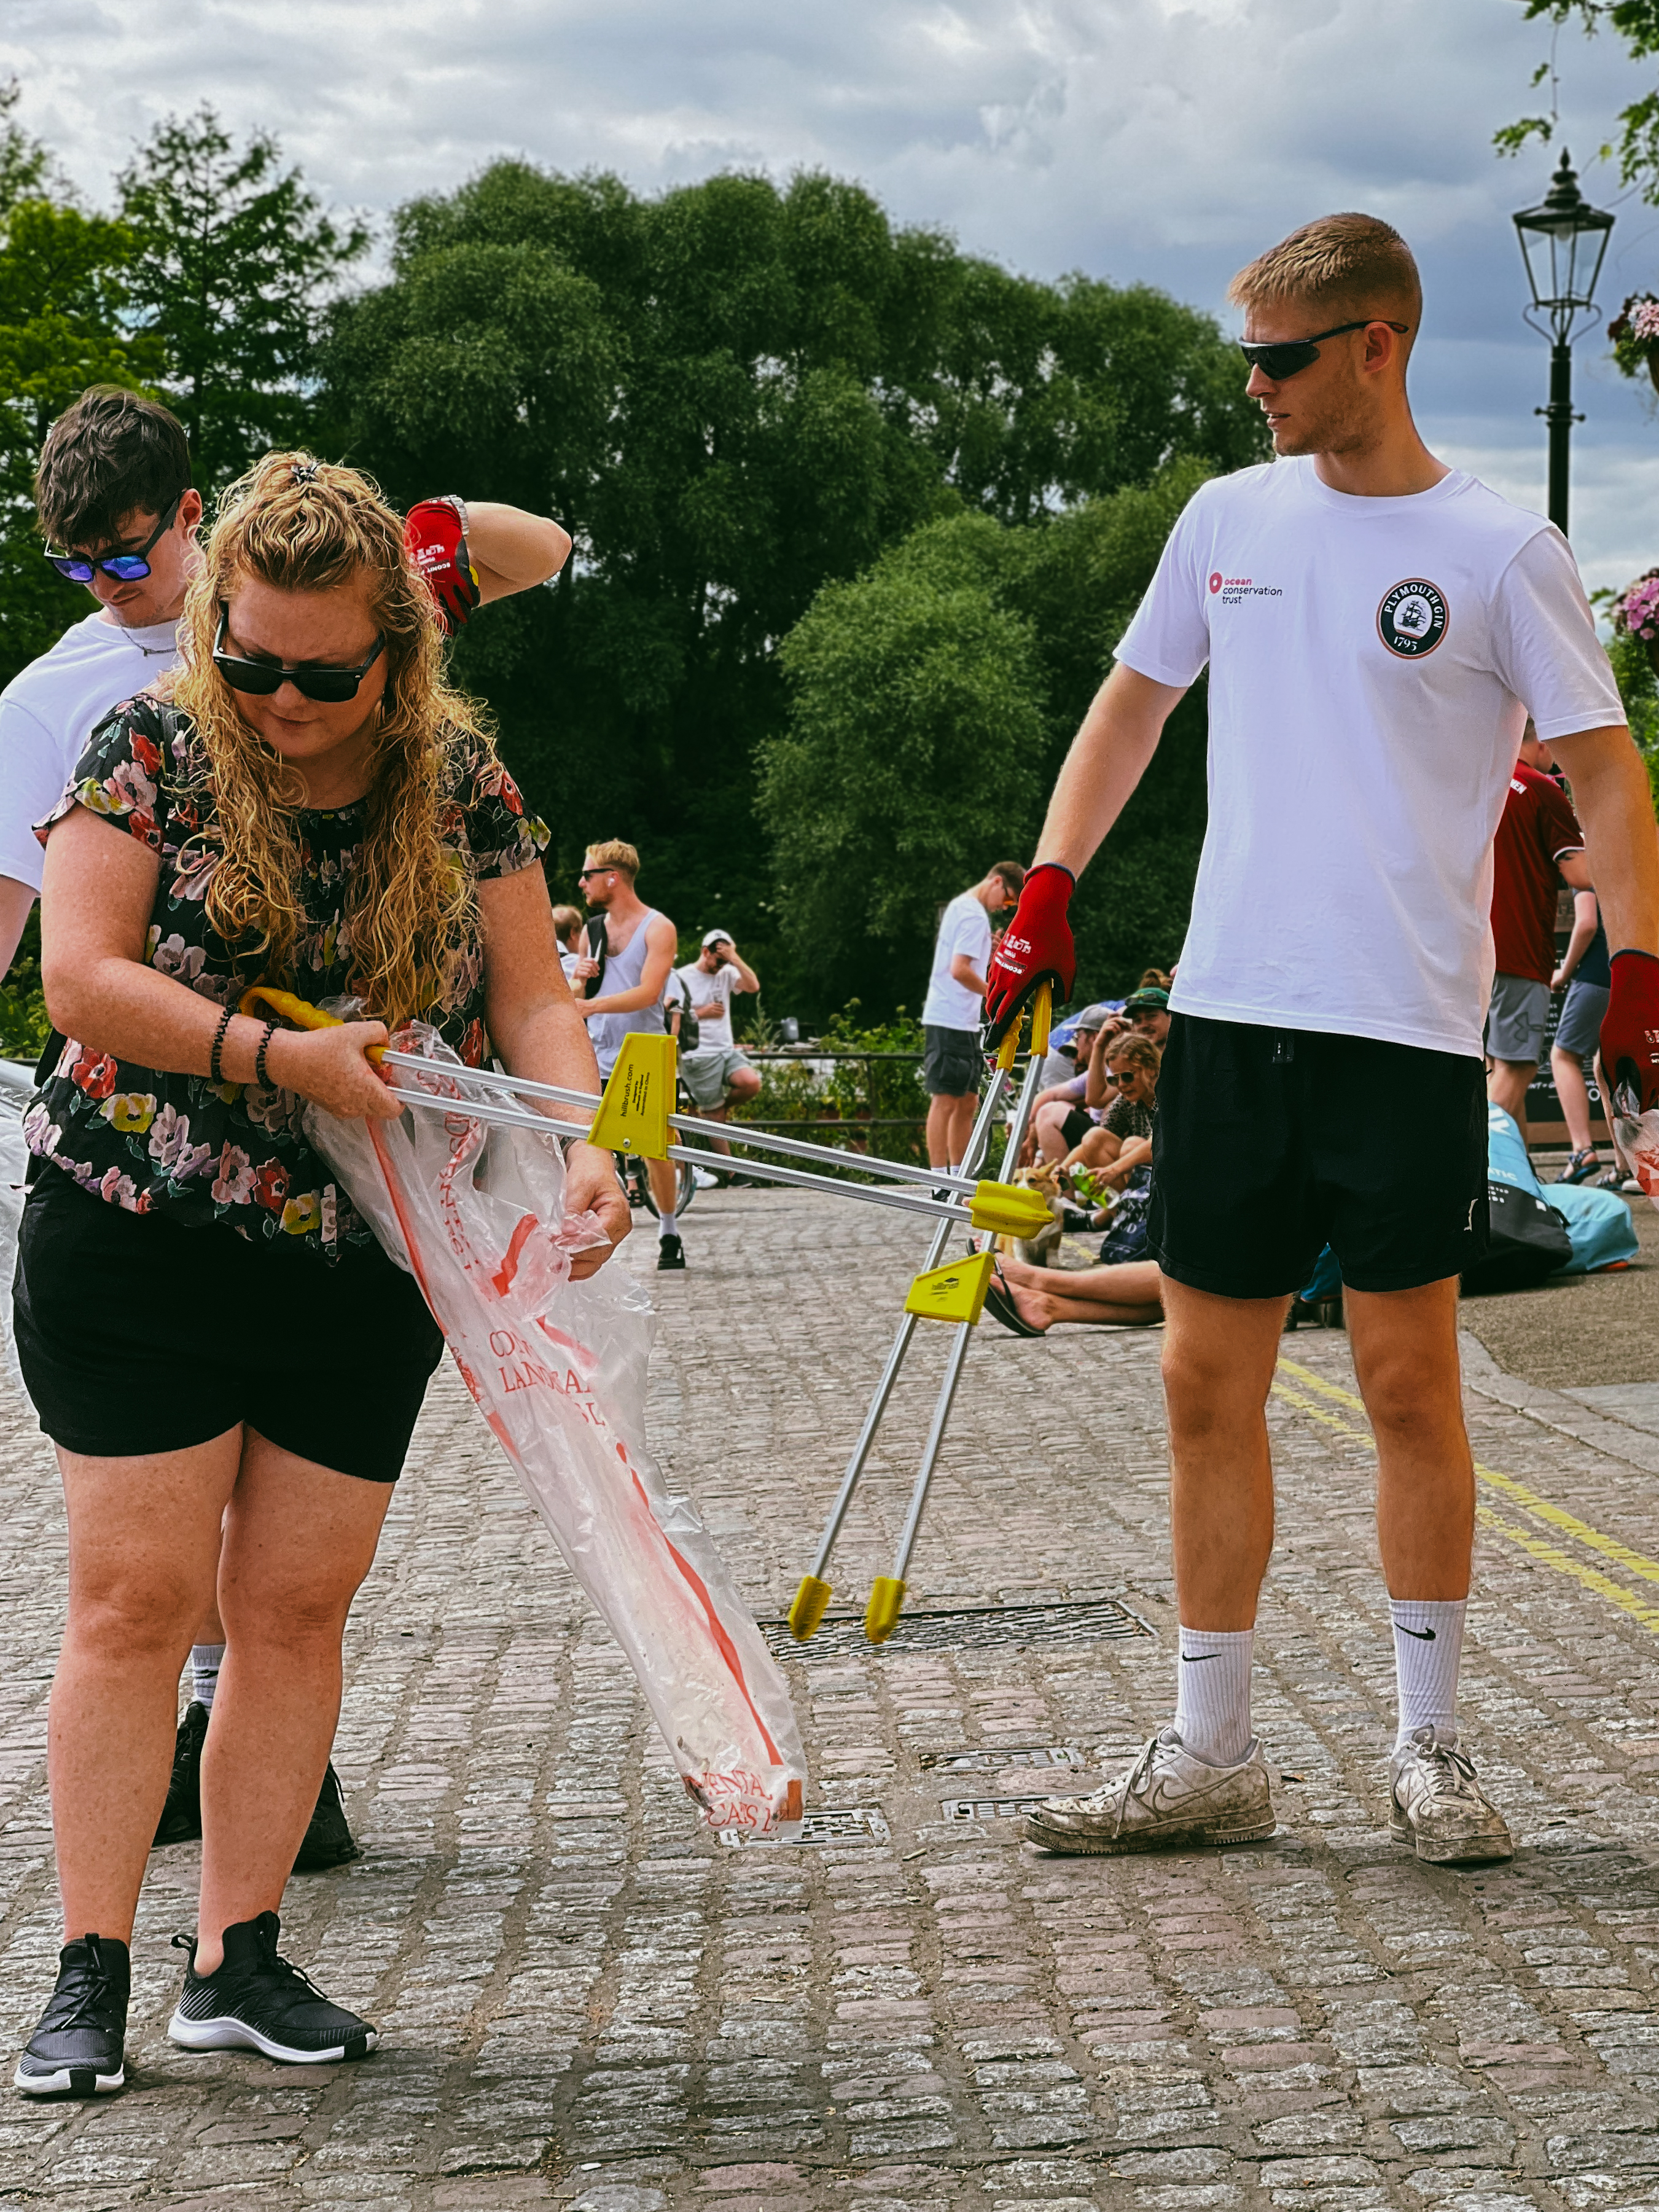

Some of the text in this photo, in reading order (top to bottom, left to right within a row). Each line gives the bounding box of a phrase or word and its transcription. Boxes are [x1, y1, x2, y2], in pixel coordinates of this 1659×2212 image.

[1222, 596, 1242, 604] trust
[1223, 585, 1282, 596] conservation
[1384, 584, 1444, 629] PLYMOUTH GIN
[620, 1064, 634, 1117] hillbrush.com
